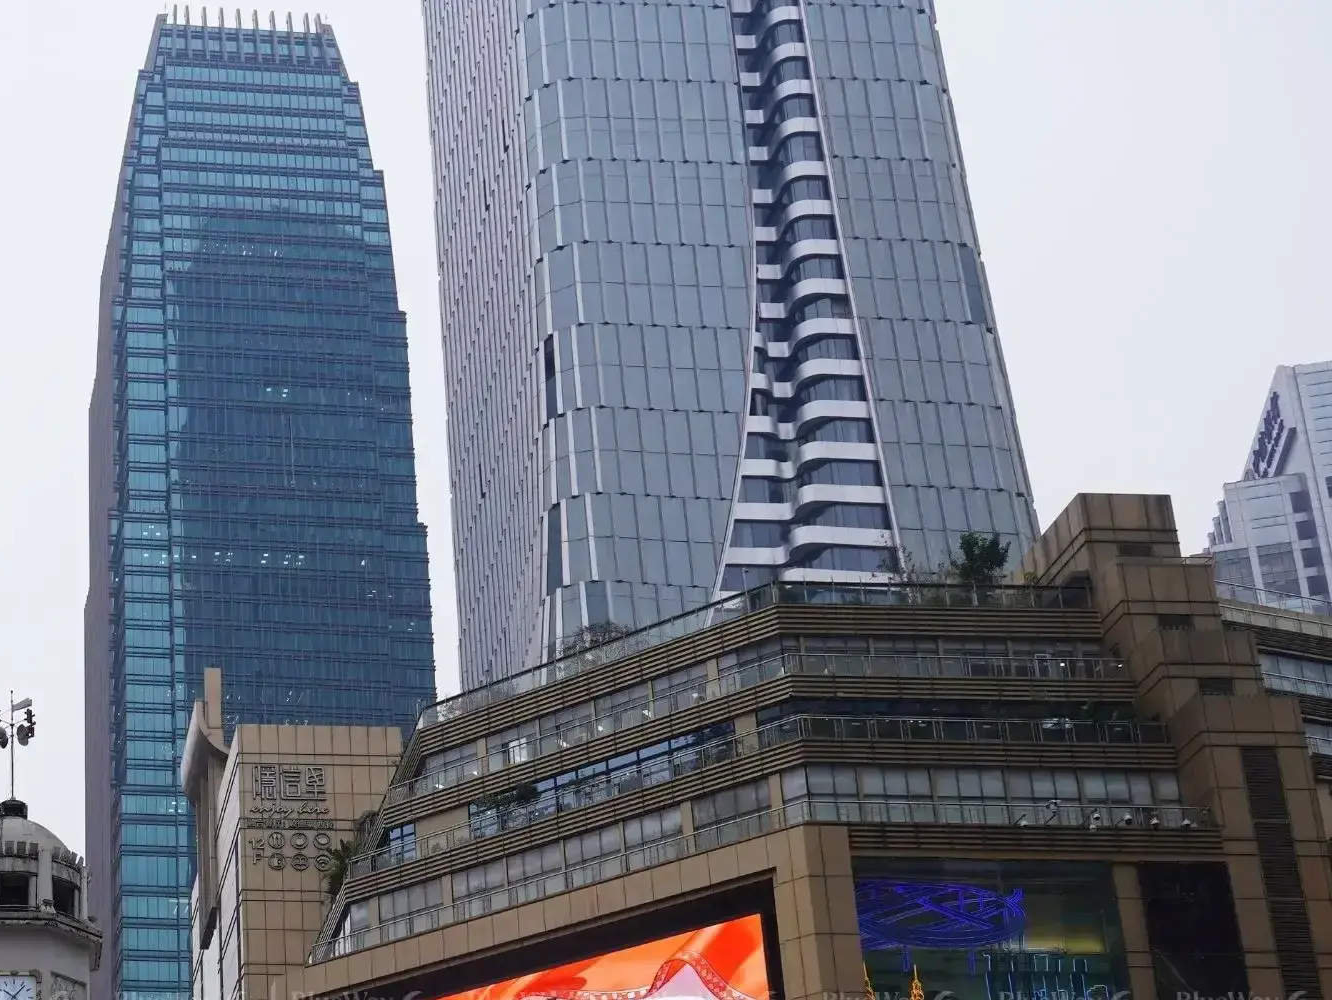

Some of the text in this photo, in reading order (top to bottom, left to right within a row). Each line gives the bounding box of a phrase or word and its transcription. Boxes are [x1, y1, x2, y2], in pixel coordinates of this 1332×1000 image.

[249, 800, 330, 818] enjoy here
[248, 838, 265, 850] 12
[252, 851, 262, 865] F
